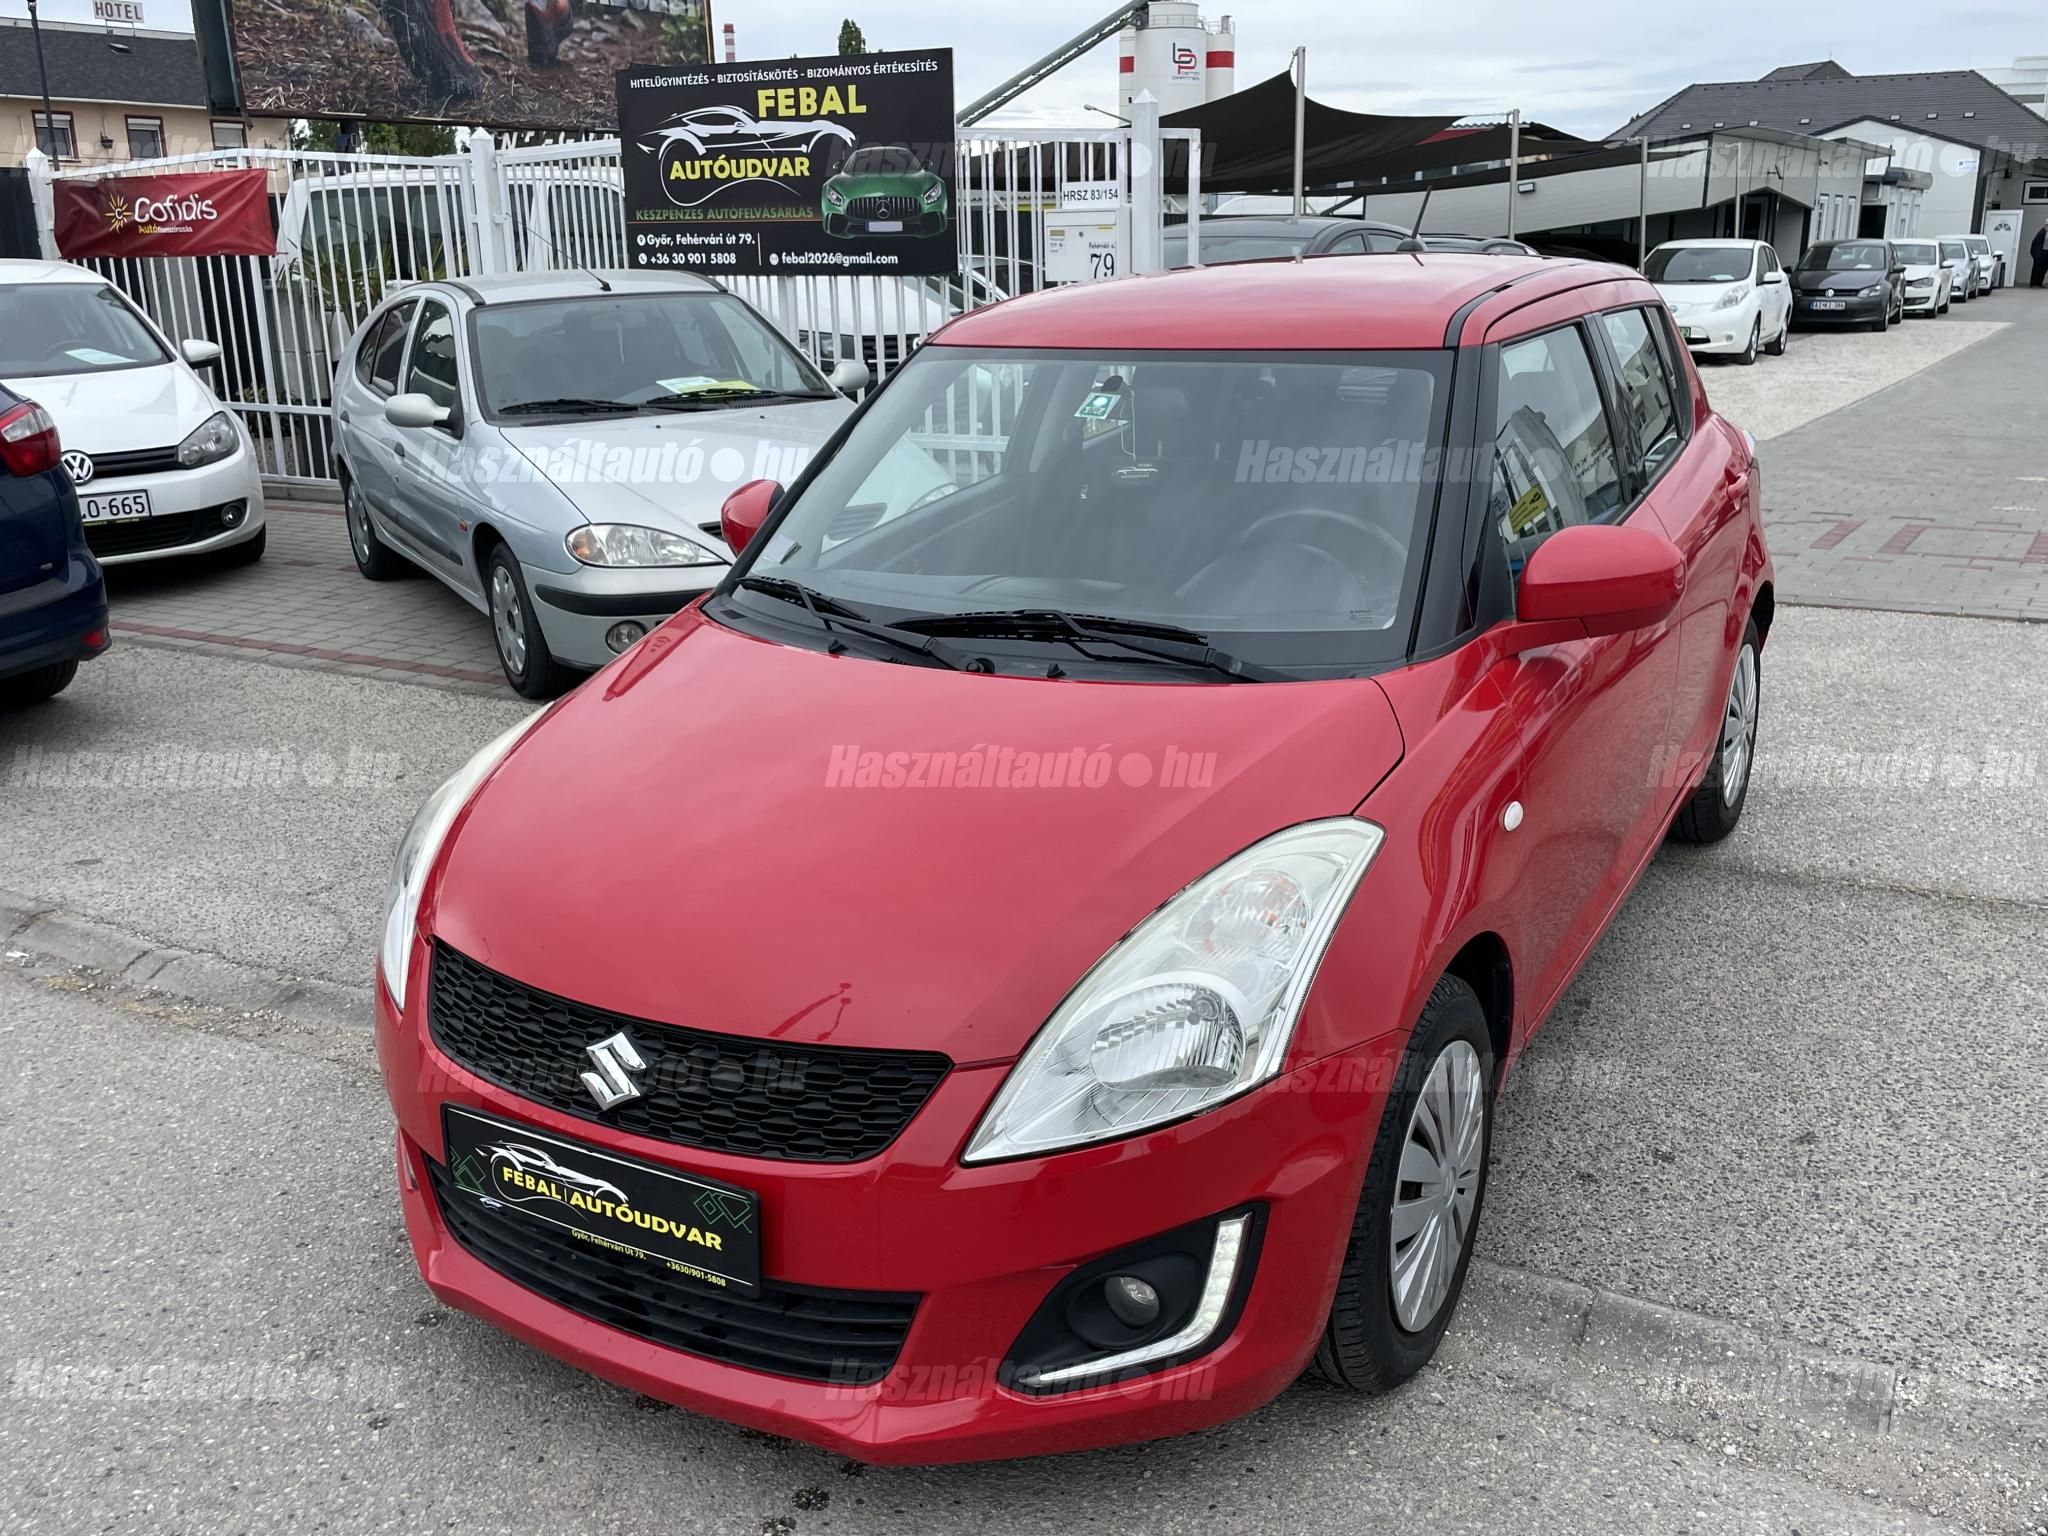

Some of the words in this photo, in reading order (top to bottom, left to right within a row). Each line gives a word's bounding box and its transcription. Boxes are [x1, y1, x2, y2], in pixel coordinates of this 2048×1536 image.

[95, 1, 142, 20] HOTEL
[630, 75, 709, 88] HITELÜGYINTÉZÉS
[717, 69, 798, 84] BIZTOSÍTÁSKÖTÉS
[807, 64, 872, 78] BIZOMÁNYOS
[873, 60, 938, 75] ÉRTÉKESÍTÉS
[757, 84, 867, 118] FEBAL
[669, 154, 811, 180] AUTÓUDVAR
[1063, 190, 1088, 200] HRSZ
[1090, 188, 1119, 200] 83/154
[134, 193, 218, 223] Cofidis
[635, 207, 704, 221] KÉSZPÉNZES
[706, 204, 814, 221] AUTÓFELVÁSÁRLÁS
[647, 234, 674, 248] Győr,
[676, 233, 723, 246] Fehérvári
[726, 233, 737, 245] út
[739, 232, 756, 245] 79.
[650, 253, 669, 265] +36
[671, 253, 685, 265] 30
[687, 253, 707, 265] 901
[710, 252, 737, 265] 5808
[781, 252, 898, 266] febal2026@gmail.com
[502, 1166, 562, 1201] FEBAL
[570, 1191, 722, 1250] AUTÓUDVAR
[571, 1229, 590, 1243] Győr,
[590, 1235, 624, 1253] Fehérvári
[634, 1249, 647, 1260] 79.
[666, 1261, 726, 1287] +3630/901-5808
